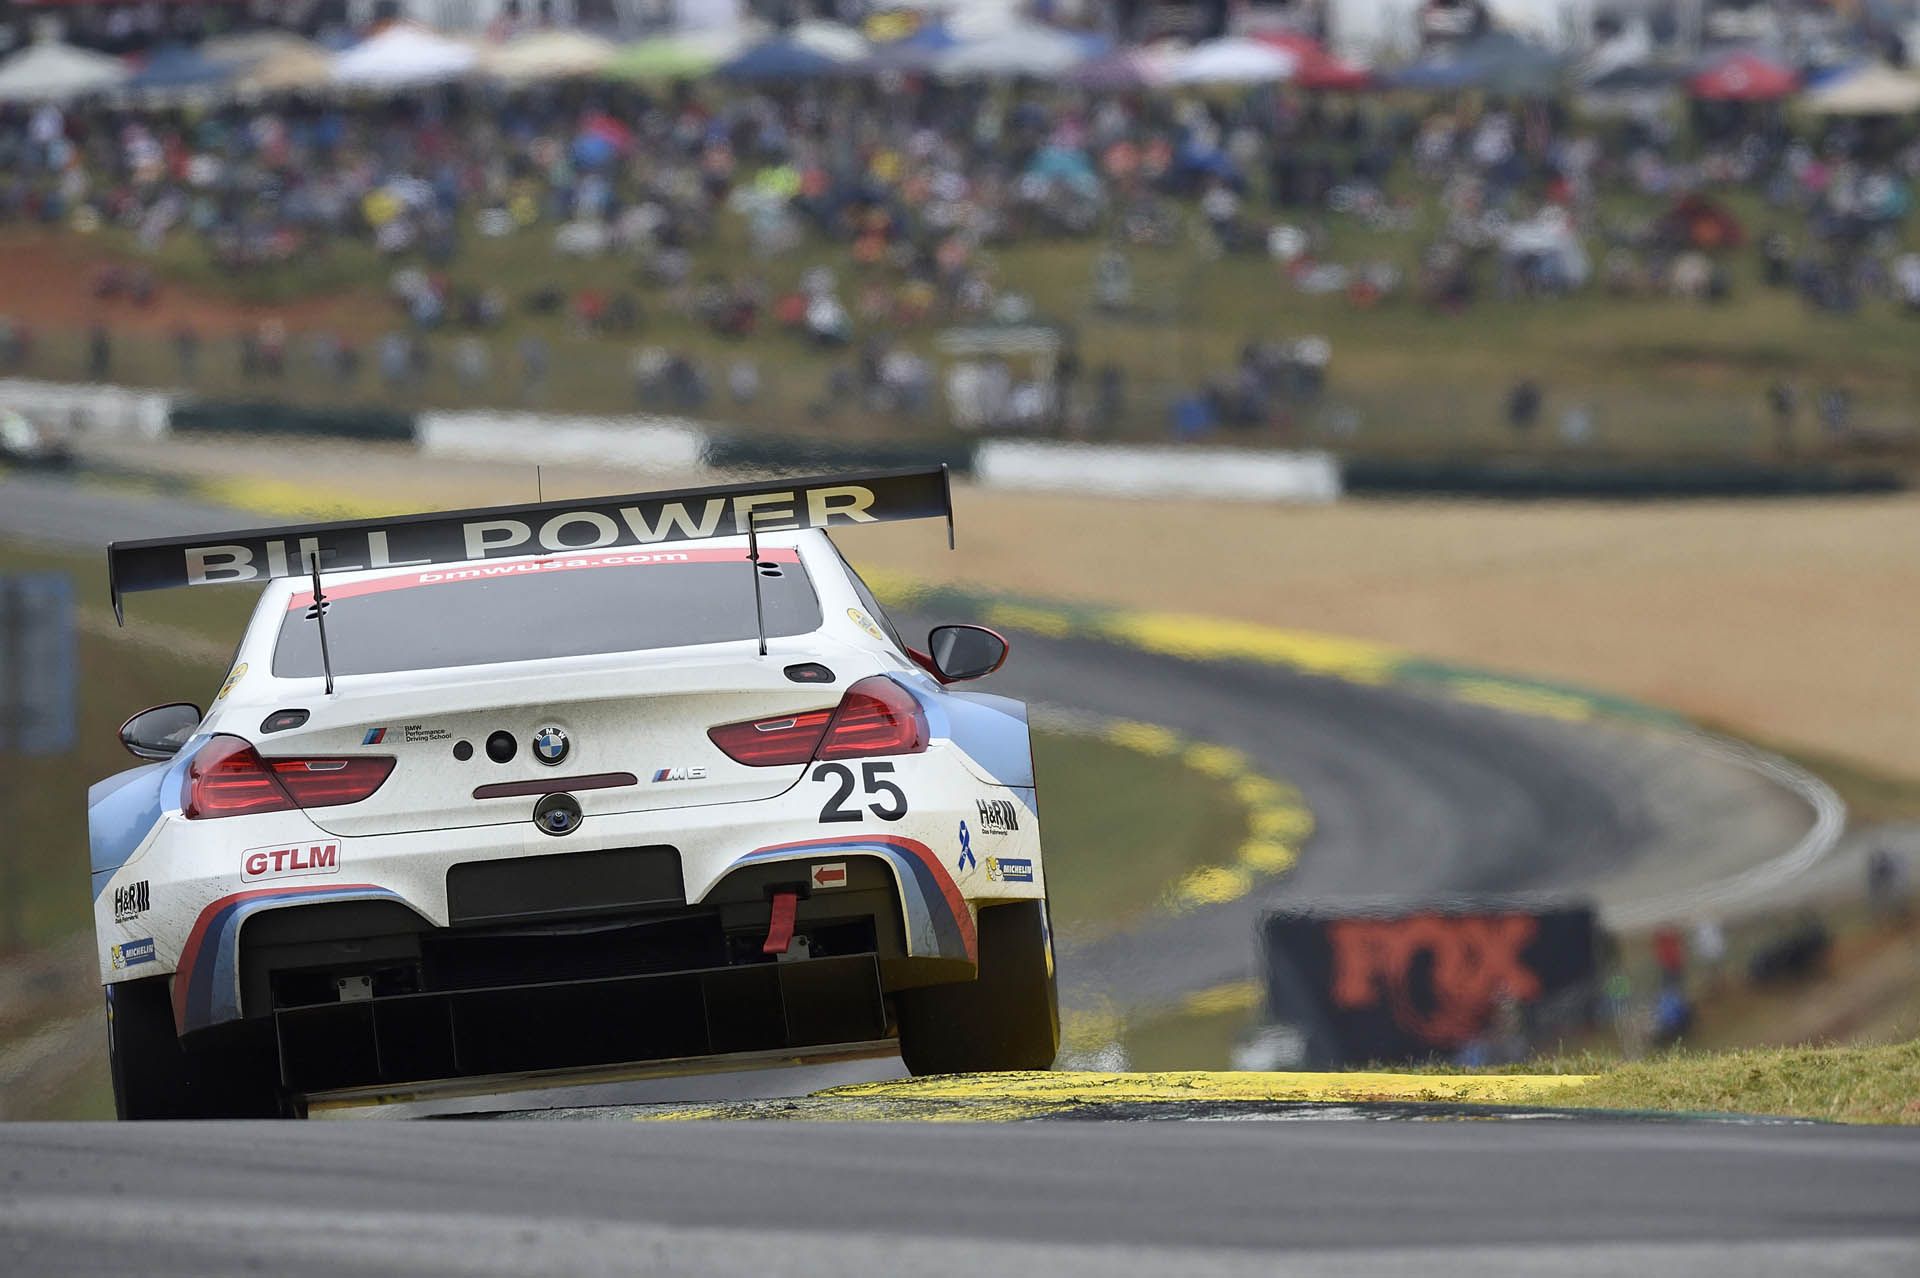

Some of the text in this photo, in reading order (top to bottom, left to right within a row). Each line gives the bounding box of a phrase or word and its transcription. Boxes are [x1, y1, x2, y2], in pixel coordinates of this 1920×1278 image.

[185, 485, 879, 586] BILL POWER
[418, 551, 688, 584] bmwusa.com
[535, 728, 567, 741] BMW
[811, 761, 908, 824] 25
[245, 845, 336, 875] GTLM
[1003, 864, 1032, 874] MICHELIN
[126, 943, 154, 959] MICHELIN
[1328, 910, 1543, 1047] FOX
